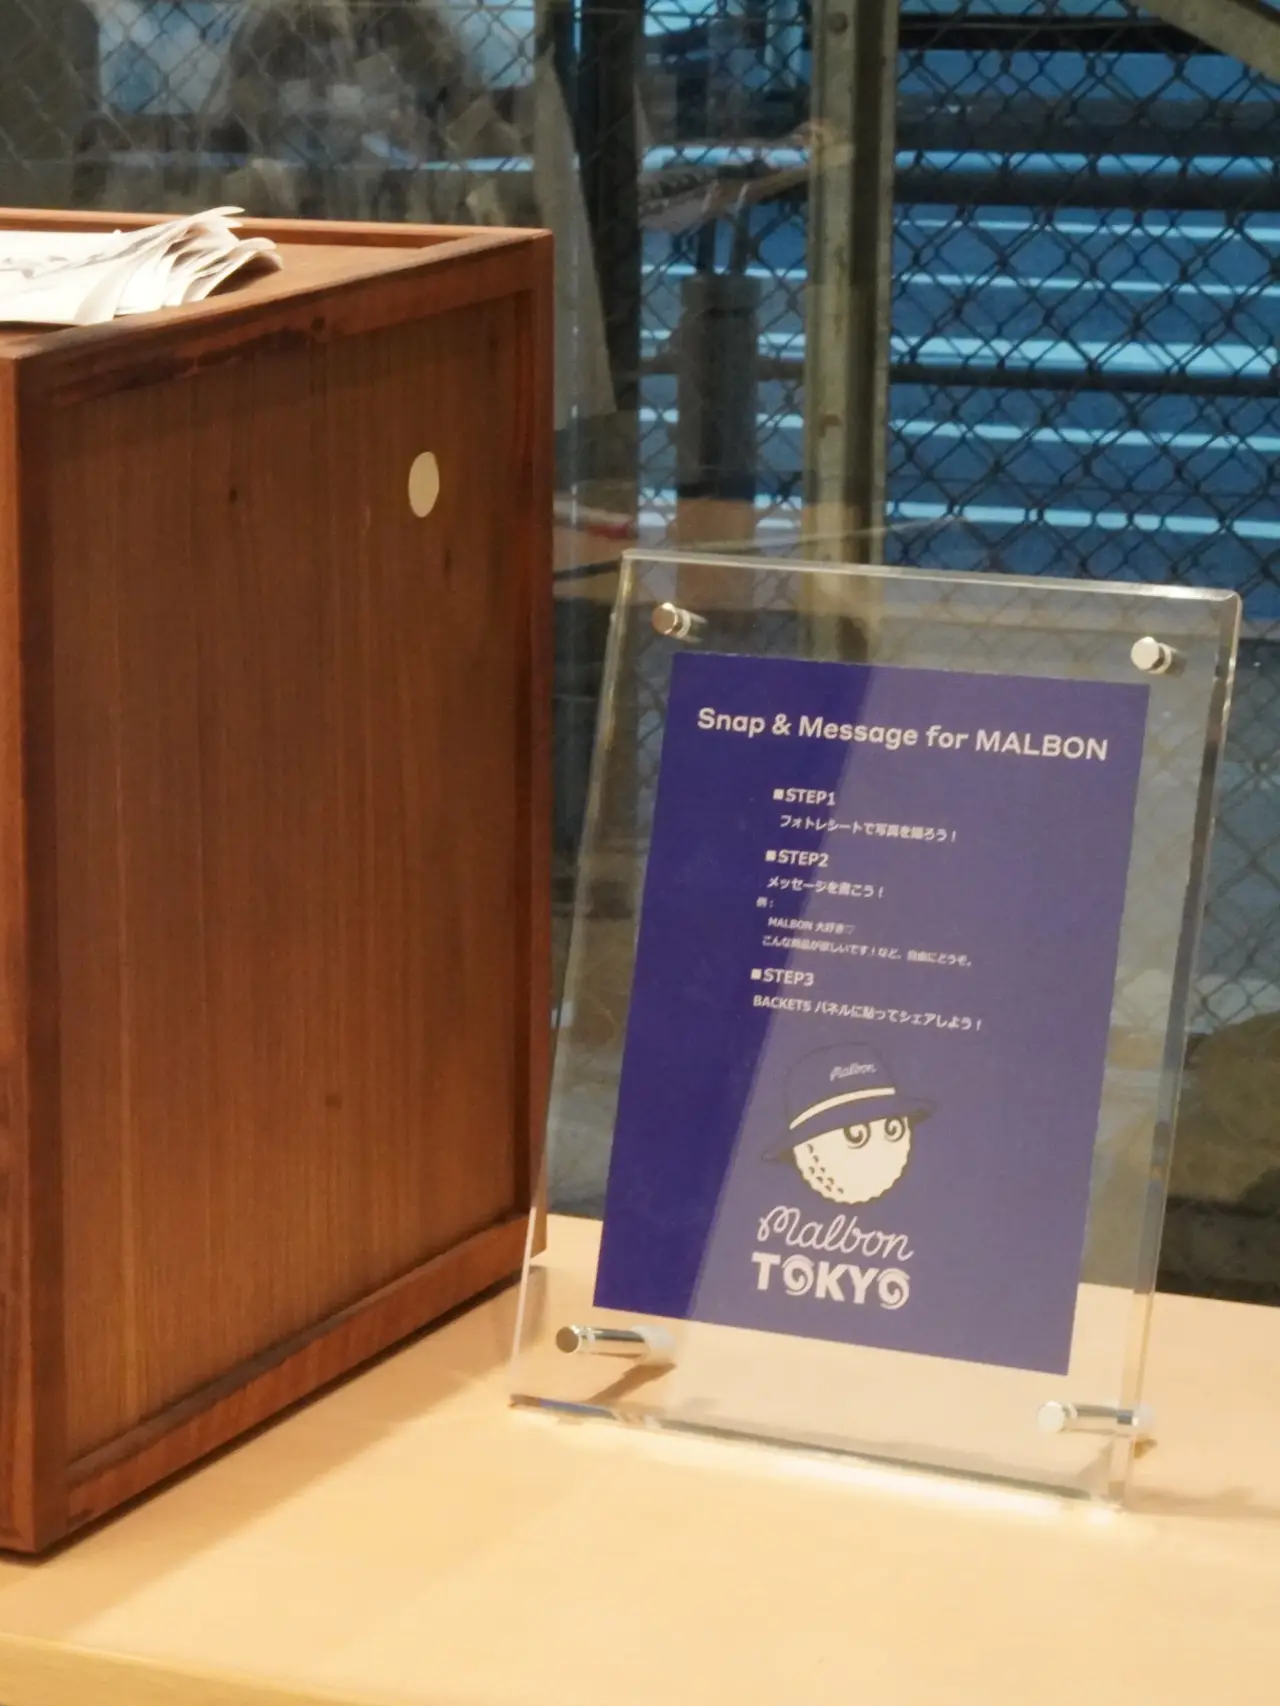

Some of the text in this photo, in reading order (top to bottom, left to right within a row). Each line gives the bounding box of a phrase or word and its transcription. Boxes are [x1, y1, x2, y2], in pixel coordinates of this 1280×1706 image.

[698, 707, 1109, 761] Snap & Message for MALBON
[757, 1205, 914, 1262] Malbon
[752, 1251, 910, 1310] TOKYO
